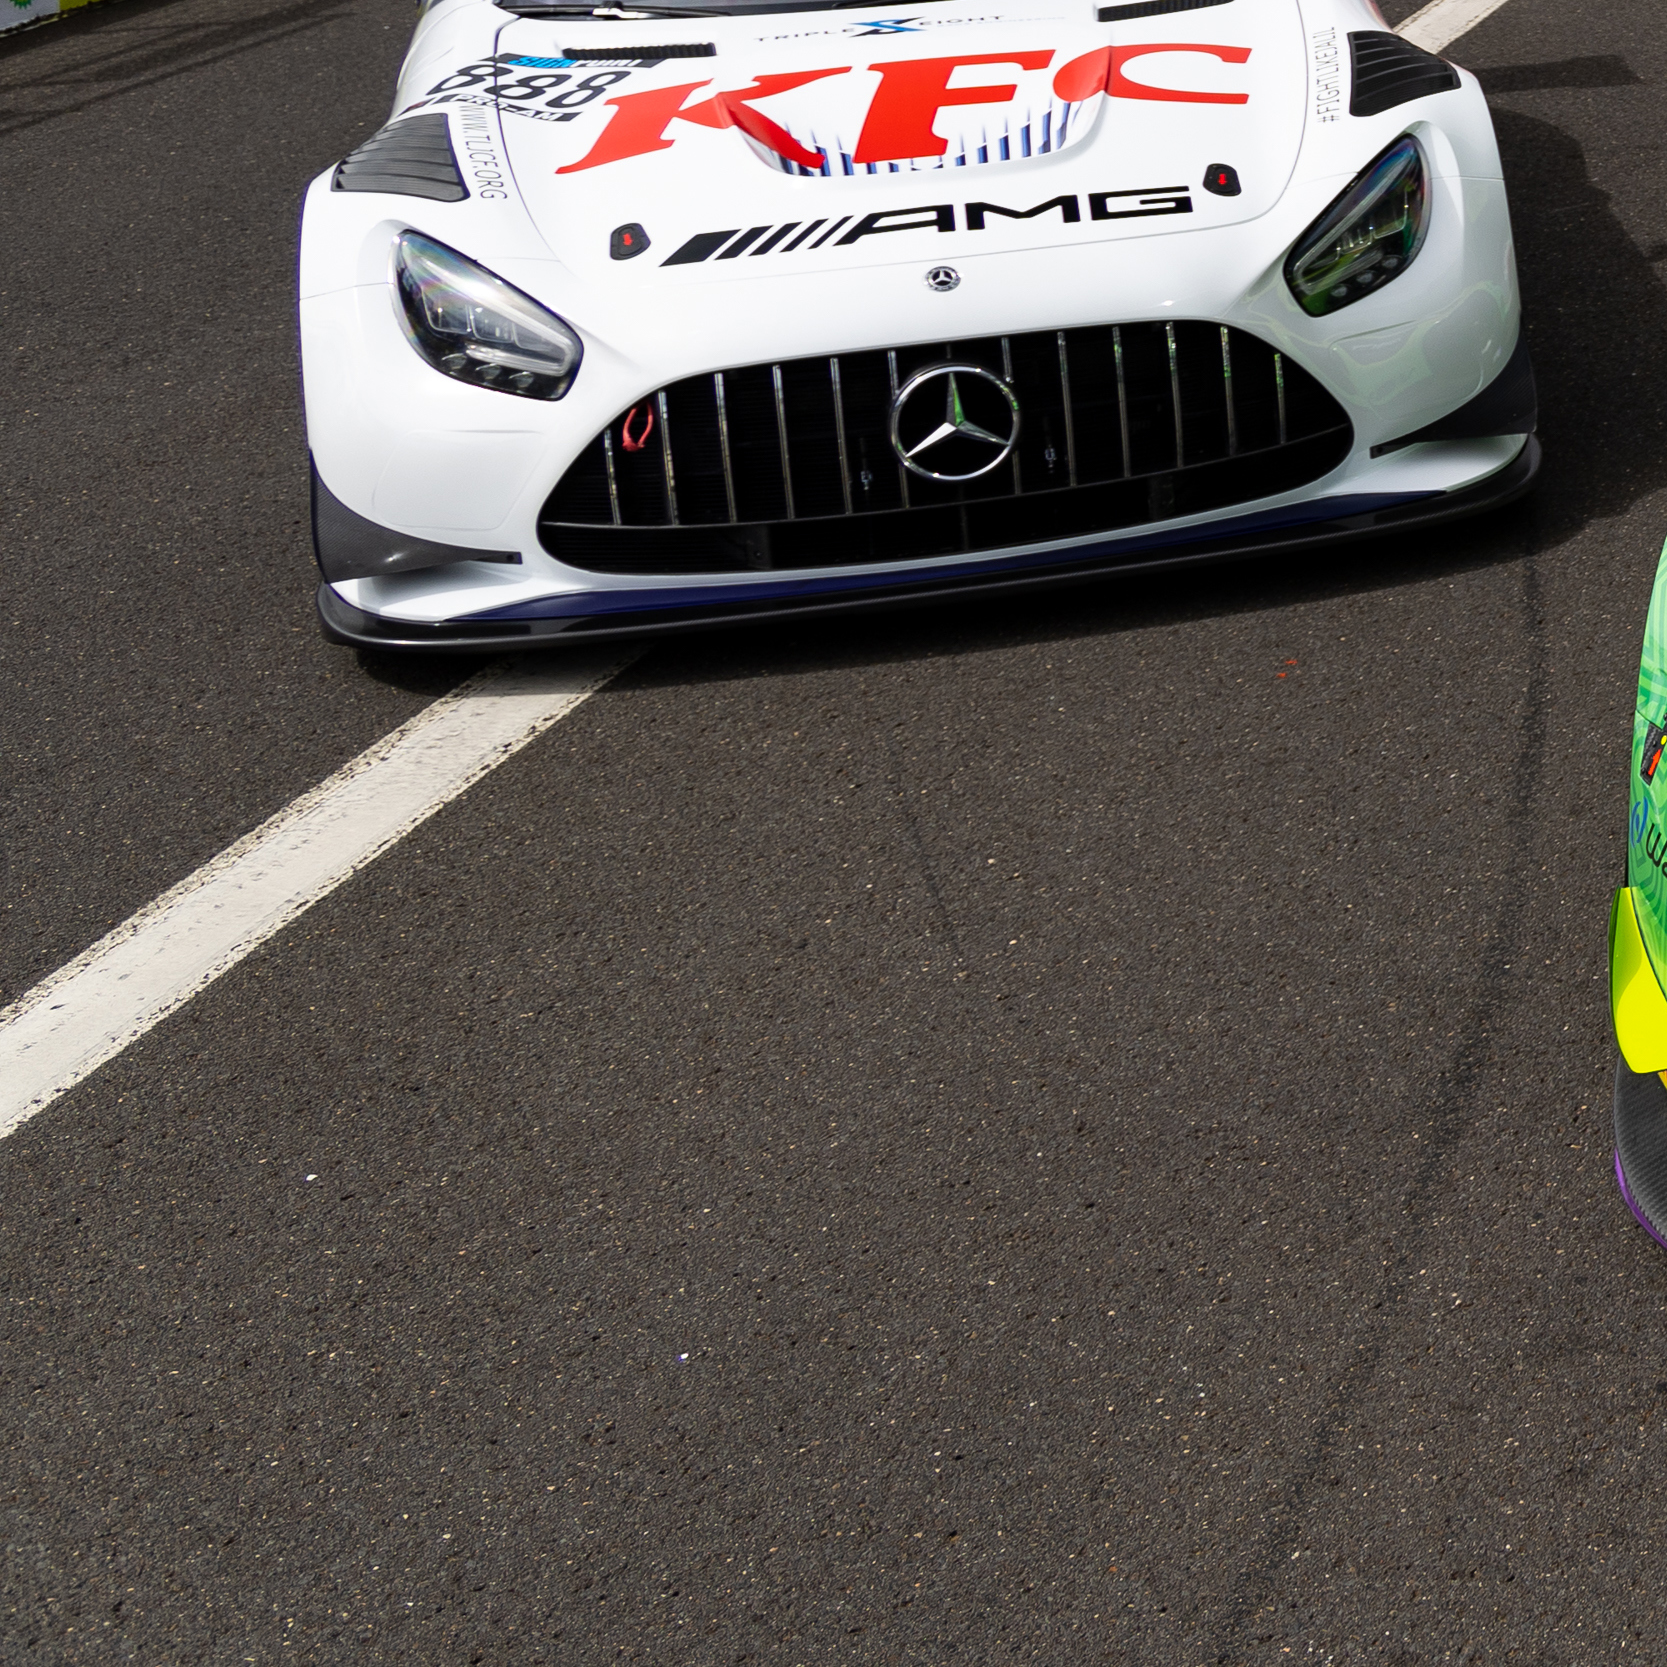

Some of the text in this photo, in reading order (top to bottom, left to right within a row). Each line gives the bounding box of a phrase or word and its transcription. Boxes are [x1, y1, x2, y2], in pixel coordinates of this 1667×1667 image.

[757, 15, 1004, 42] TRIPLE EIGHT
[426, 64, 632, 109] 888
[451, 93, 565, 122] PRO-AM
[554, 43, 1252, 176] KFC
[833, 186, 1193, 248] AMG
